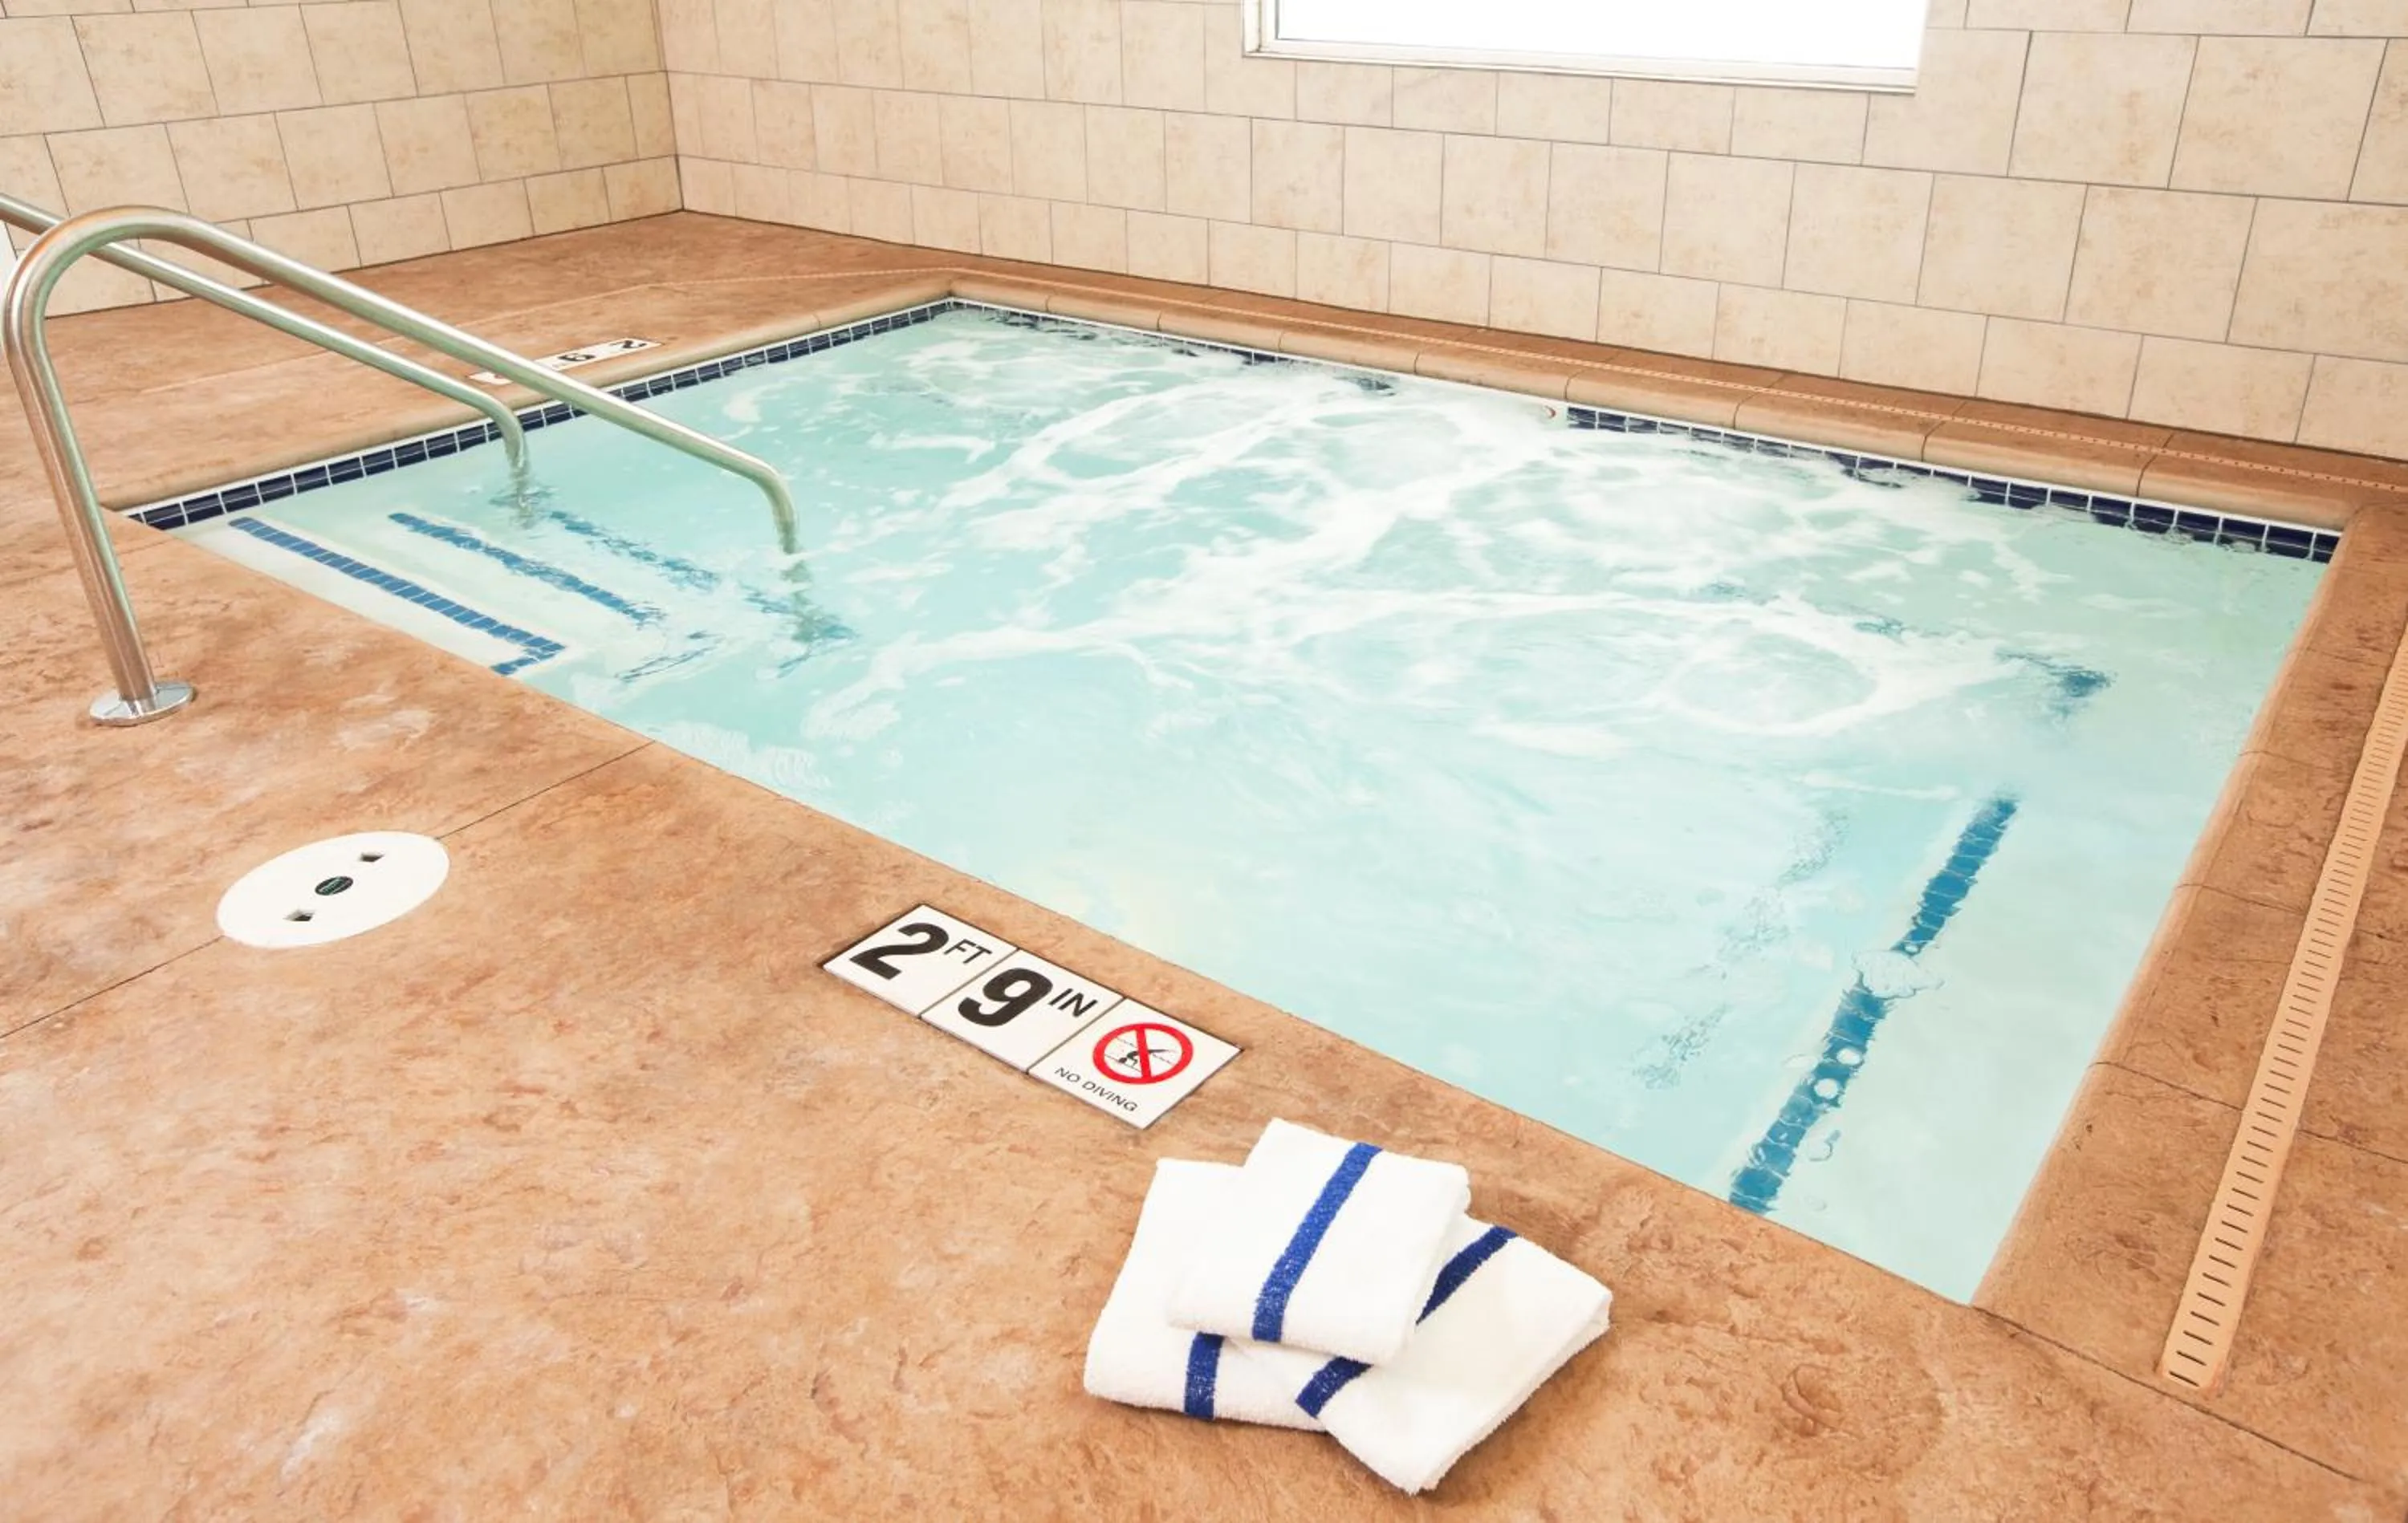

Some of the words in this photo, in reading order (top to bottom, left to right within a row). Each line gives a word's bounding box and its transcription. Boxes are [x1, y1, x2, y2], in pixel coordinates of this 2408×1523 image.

[849, 923, 950, 980] 2
[943, 939, 992, 965] FT
[958, 968, 1053, 1027] 9
[1049, 988, 1097, 1017] IN
[1055, 1067, 1080, 1082] NO
[1082, 1081, 1137, 1111] DIVING
